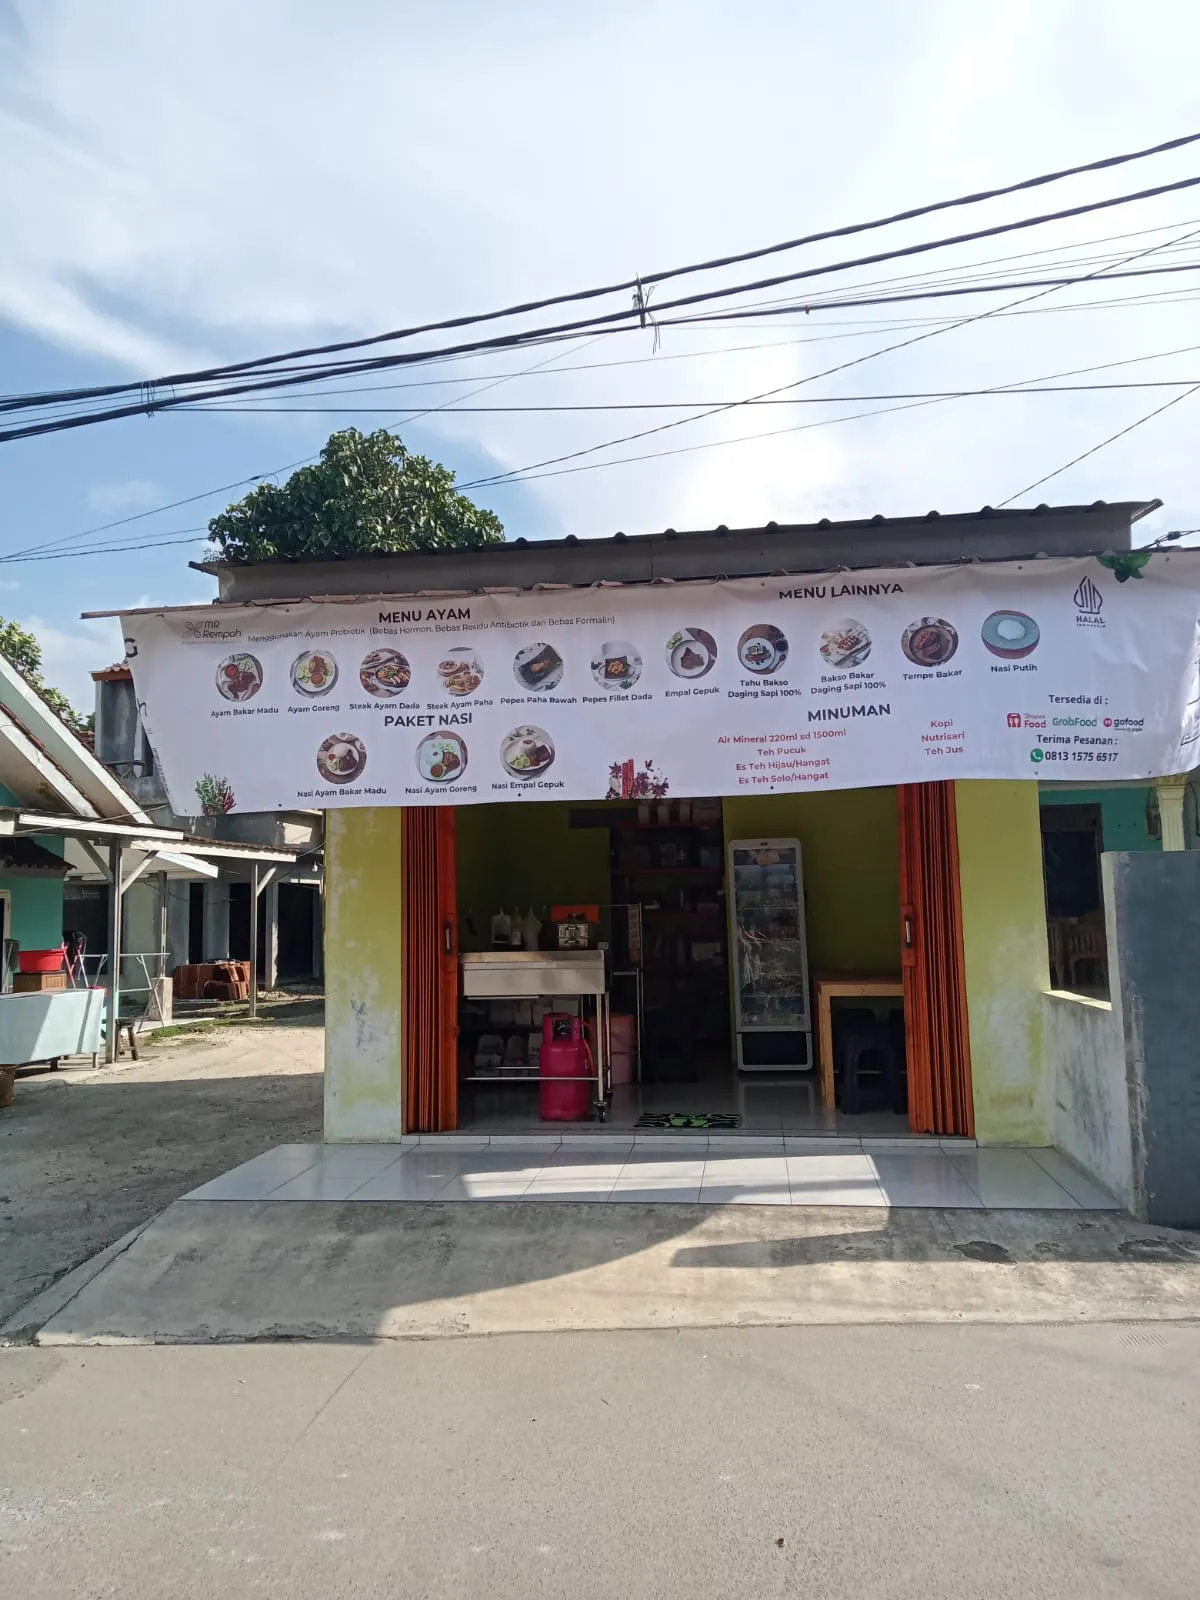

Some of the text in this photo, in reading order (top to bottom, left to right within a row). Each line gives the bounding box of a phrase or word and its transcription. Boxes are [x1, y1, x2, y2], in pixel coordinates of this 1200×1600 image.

[778, 583, 904, 600] MENU LAINNYA
[378, 607, 471, 624] MENU AYAM
[1075, 615, 1106, 624] HALAL
[247, 630, 303, 643] Menggunakan
[304, 630, 329, 639] Ayam
[330, 627, 366, 637] Probiotik
[369, 626, 398, 636] (Bebas
[435, 624, 461, 633] Bebas
[462, 621, 489, 632] Residu
[489, 620, 530, 630] Antibiotik
[530, 619, 546, 628] dan
[548, 617, 574, 627] Bebas
[575, 616, 616, 626] Formalin)
[990, 663, 1038, 673] Nasi Putih
[820, 672, 875, 683] Bakso Bakar
[902, 669, 963, 682] Tempe Bakar
[740, 678, 789, 687] Tahu Bakso
[810, 680, 886, 695] Daging Sapi 100%
[665, 687, 720, 698] Empal Gepuk
[727, 688, 802, 699] Daging Sapi 100%
[500, 697, 525, 705] Pepes
[526, 697, 548, 705] Paha
[582, 693, 653, 704] Pepes Fillet Dada
[1049, 694, 1091, 705] Tersedia
[1093, 695, 1103, 705] di
[287, 703, 340, 714] Ayam Goreng
[349, 702, 420, 711] Steak Ayam Dada
[426, 699, 494, 710] Steak Ayam Paha
[211, 706, 279, 719] Ayam Bakar Madu
[807, 703, 891, 722] MINUMAN
[383, 712, 473, 728] PAKET NASI
[930, 719, 953, 729] Kopi
[1024, 720, 1047, 729] Food
[1052, 716, 1098, 728] GrabFood
[1113, 718, 1145, 728] gofood
[717, 728, 847, 744] Air Mineral 220ml sd 1500ml
[921, 731, 966, 743] Nutrisari
[1036, 734, 1071, 745] Terima
[1073, 735, 1114, 745] Pesanan
[757, 746, 807, 757] Teh Pucuk
[924, 746, 964, 756] Teh Jus
[1045, 751, 1119, 762] 0813 1575 6517
[735, 757, 831, 771] Es Teh Hijau/Hangat
[738, 772, 829, 785] Es Teh Solo/Hangat
[405, 785, 478, 796] Nasi Ayam Goreng
[491, 780, 565, 791] Nasi Empal Gepuk
[297, 787, 388, 800] Nasi Ayam Bakar Madu
